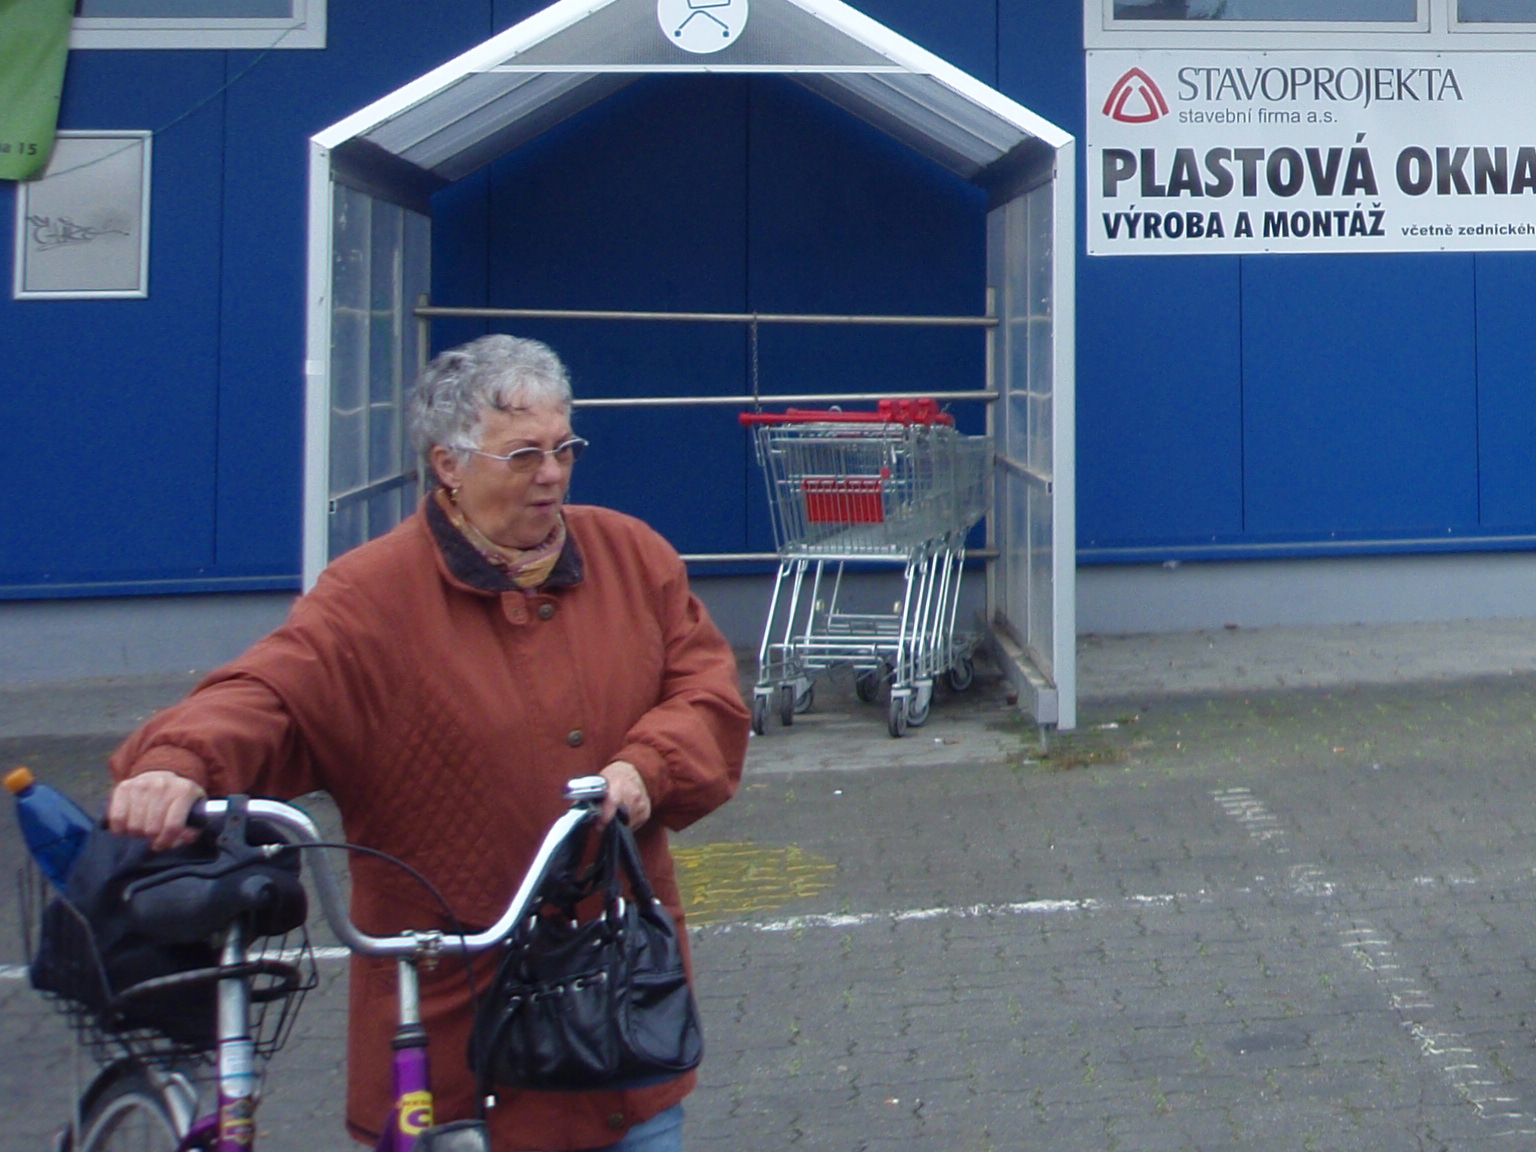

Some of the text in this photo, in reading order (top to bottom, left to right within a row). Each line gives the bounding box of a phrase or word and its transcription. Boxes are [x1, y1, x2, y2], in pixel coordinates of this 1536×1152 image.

[1177, 66, 1464, 109] STAVOPROJEKTA
[1178, 107, 1338, 124] stavební firma a.s.
[1101, 132, 1379, 198] PLASTOVÁ
[1101, 204, 1226, 239] VÝROBA
[1233, 211, 1252, 239] A
[1262, 201, 1386, 239] MONTÁŽ
[1401, 223, 1453, 237] včetně
